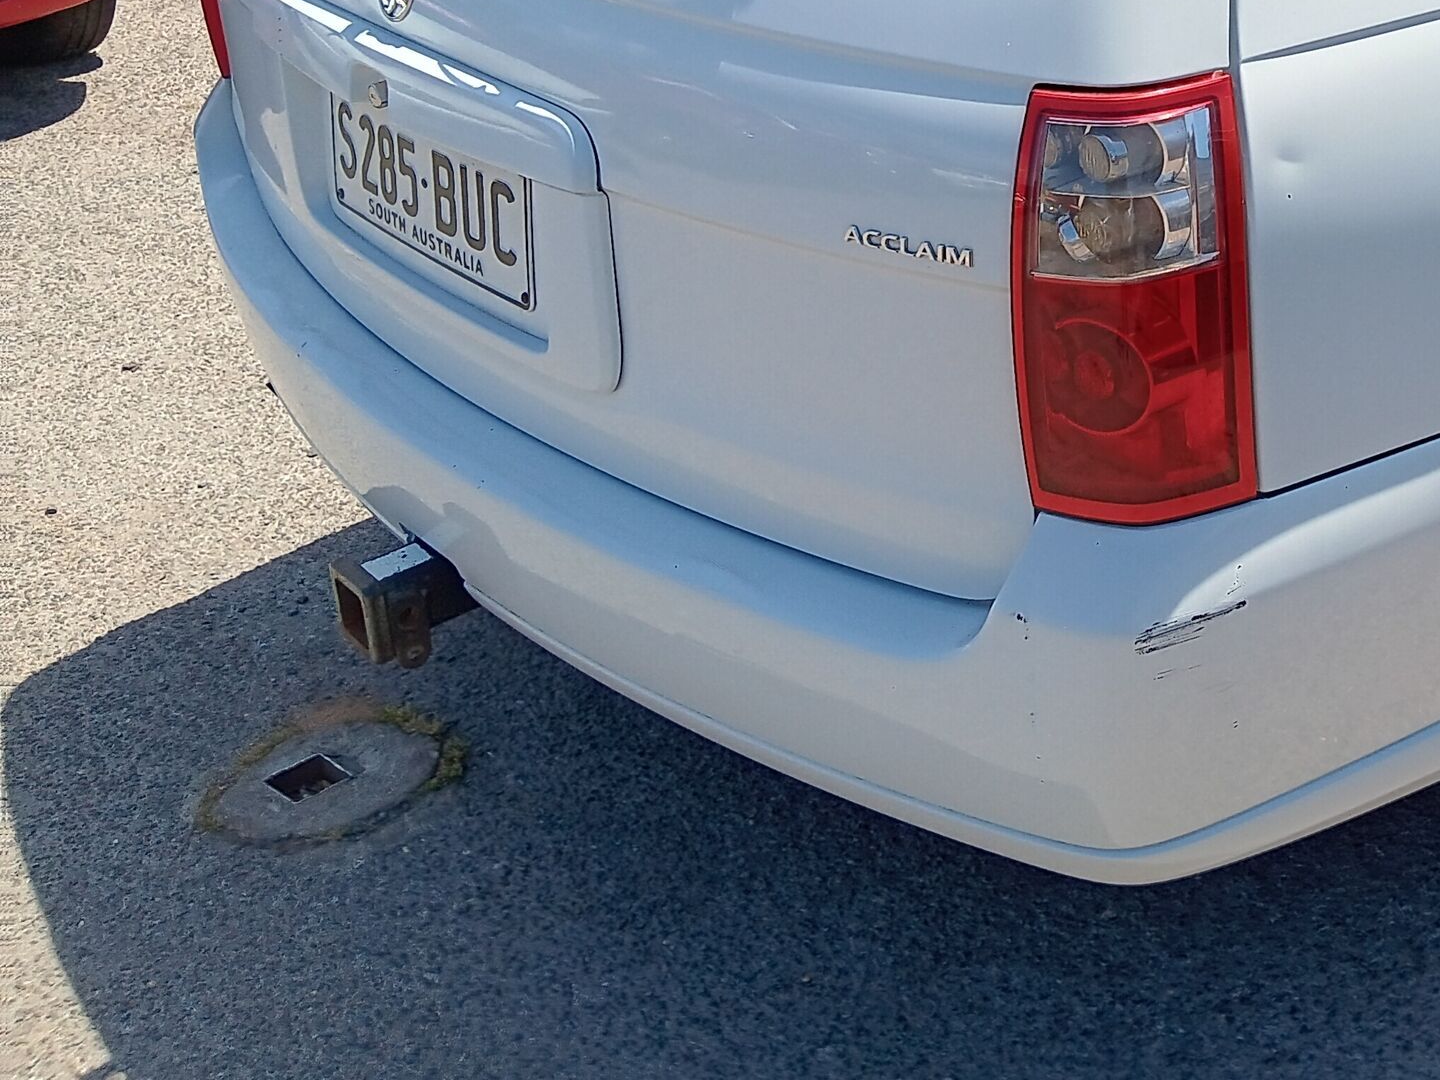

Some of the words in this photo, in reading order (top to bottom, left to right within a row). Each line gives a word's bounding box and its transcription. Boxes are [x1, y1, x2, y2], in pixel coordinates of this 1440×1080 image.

[367, 197, 408, 234] SOUTH
[410, 223, 485, 278] AUSTRALIA
[843, 223, 974, 268] ACCLAIM
